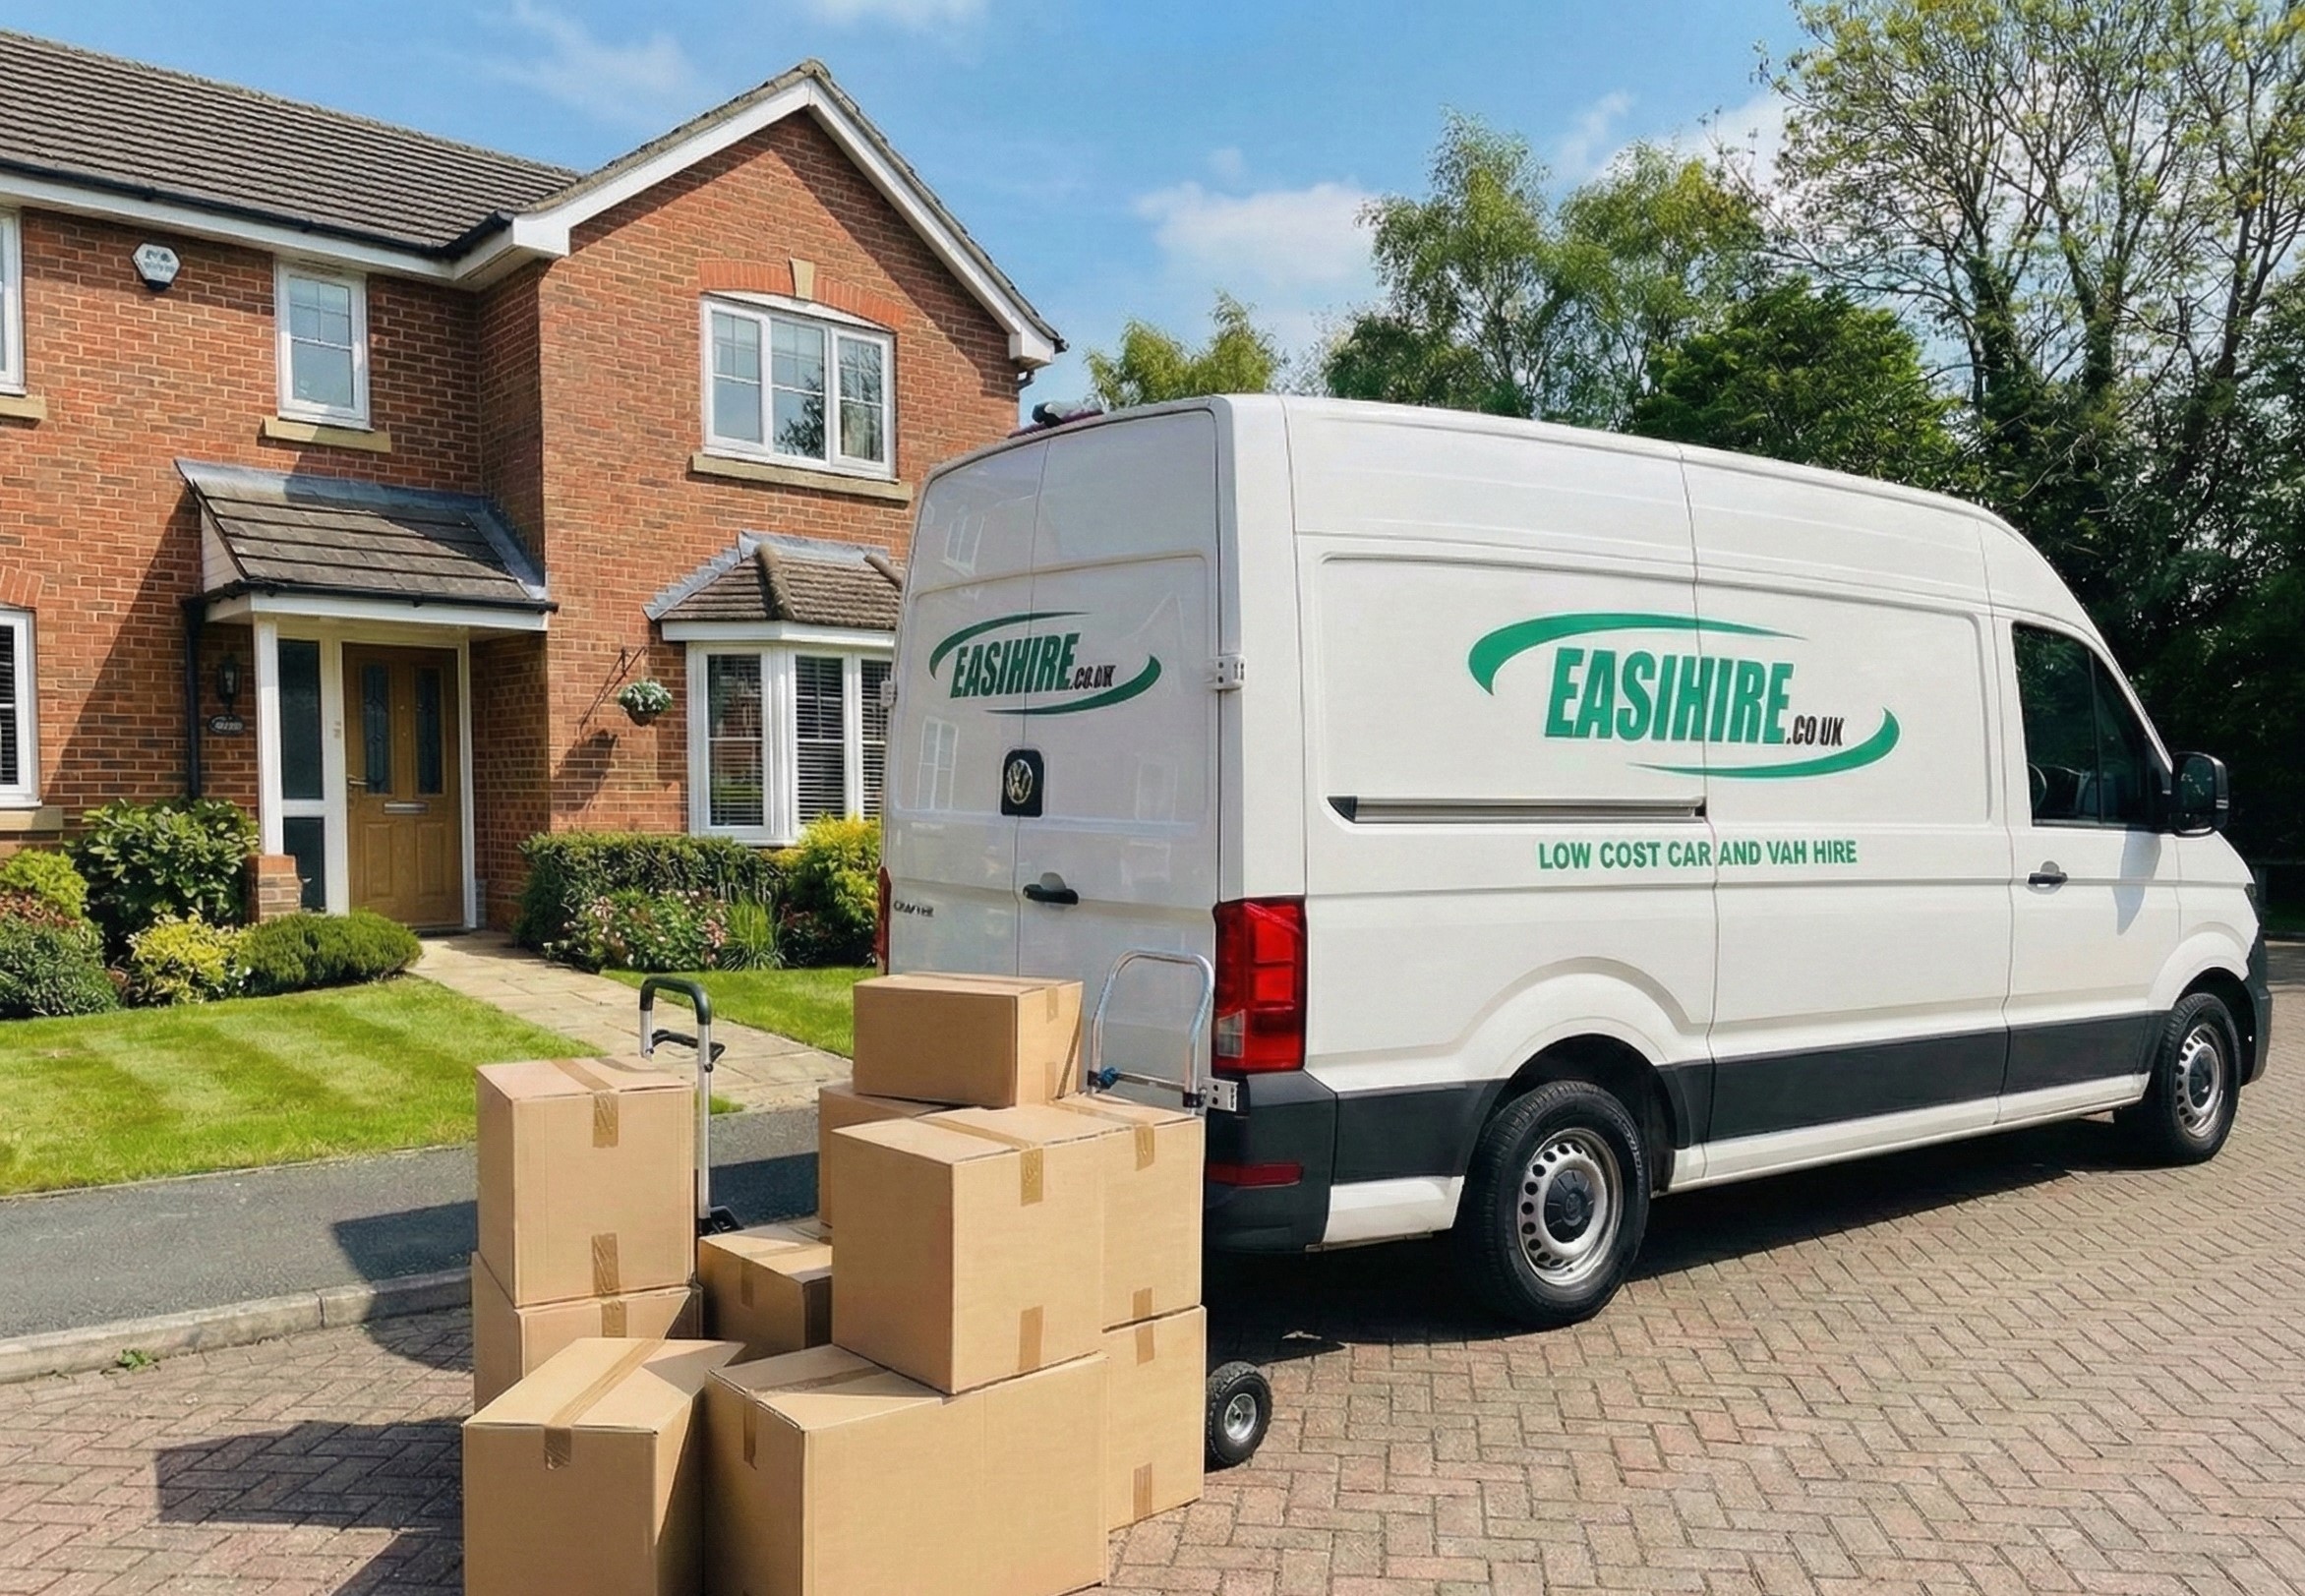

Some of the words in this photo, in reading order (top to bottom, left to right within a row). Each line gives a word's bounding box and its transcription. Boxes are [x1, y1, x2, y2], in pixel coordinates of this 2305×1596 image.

[1538, 842, 1591, 869] LOW
[1599, 841, 1661, 868] COST
[1668, 841, 1712, 867] CAR
[1718, 840, 1761, 866] AND
[1813, 840, 1858, 863] HIRE
